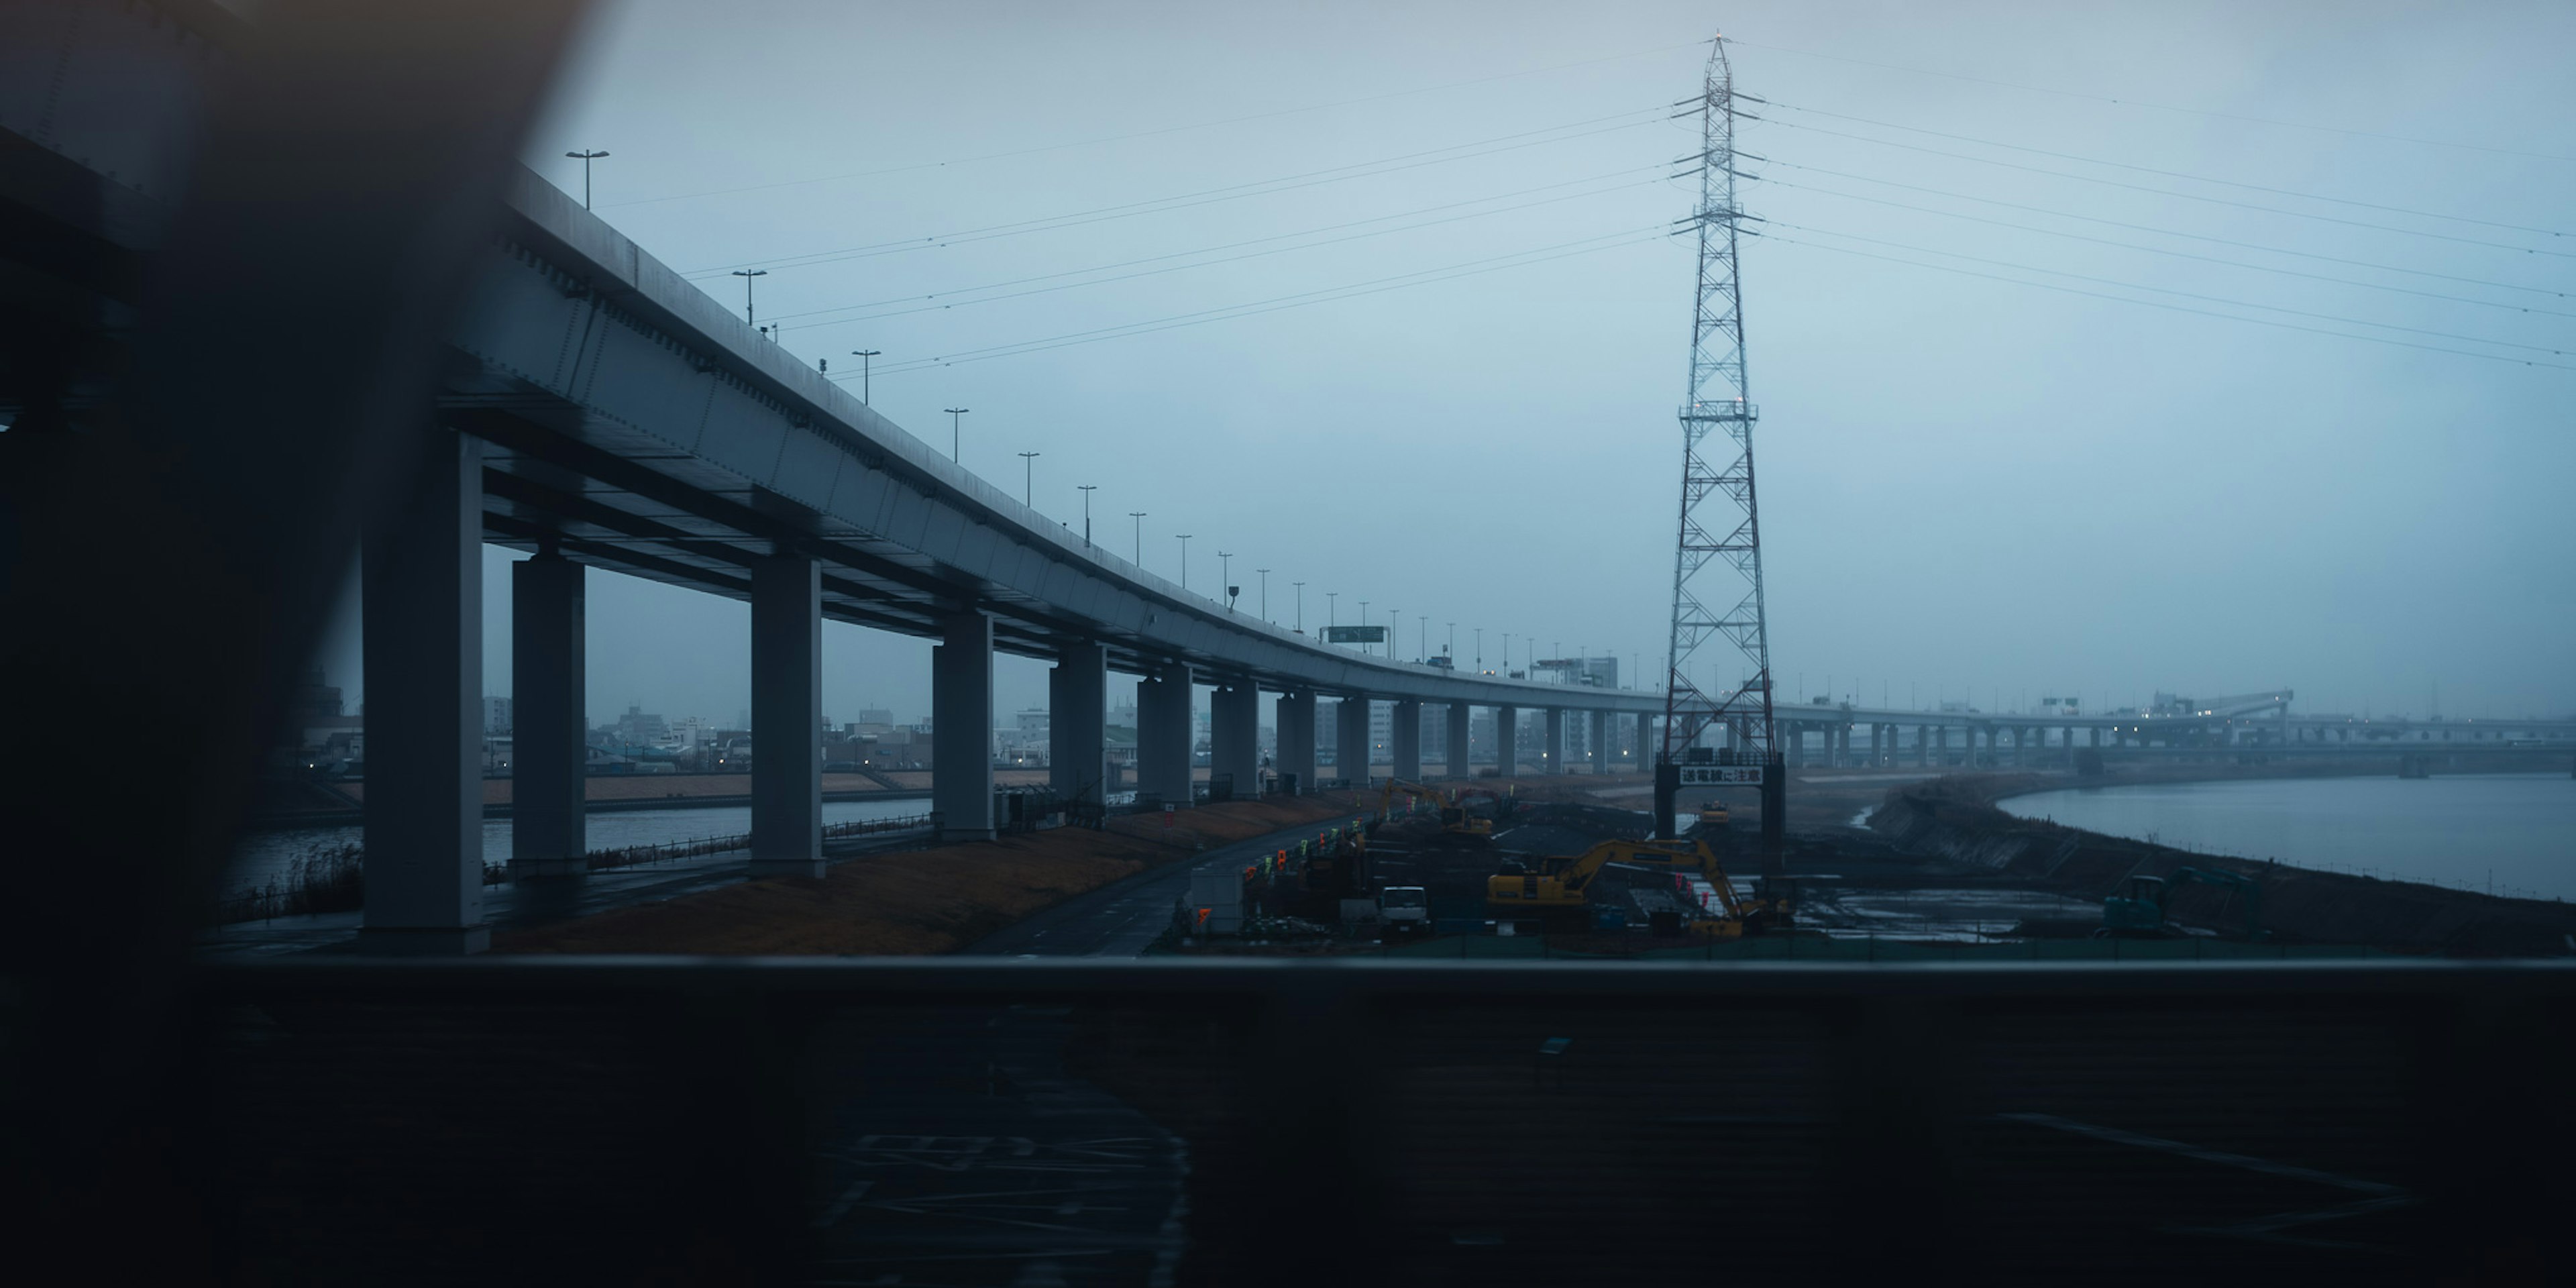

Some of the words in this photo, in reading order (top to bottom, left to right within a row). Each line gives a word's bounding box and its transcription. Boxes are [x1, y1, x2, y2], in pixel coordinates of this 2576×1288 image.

[1682, 769, 1760, 783] 送電線に注意
